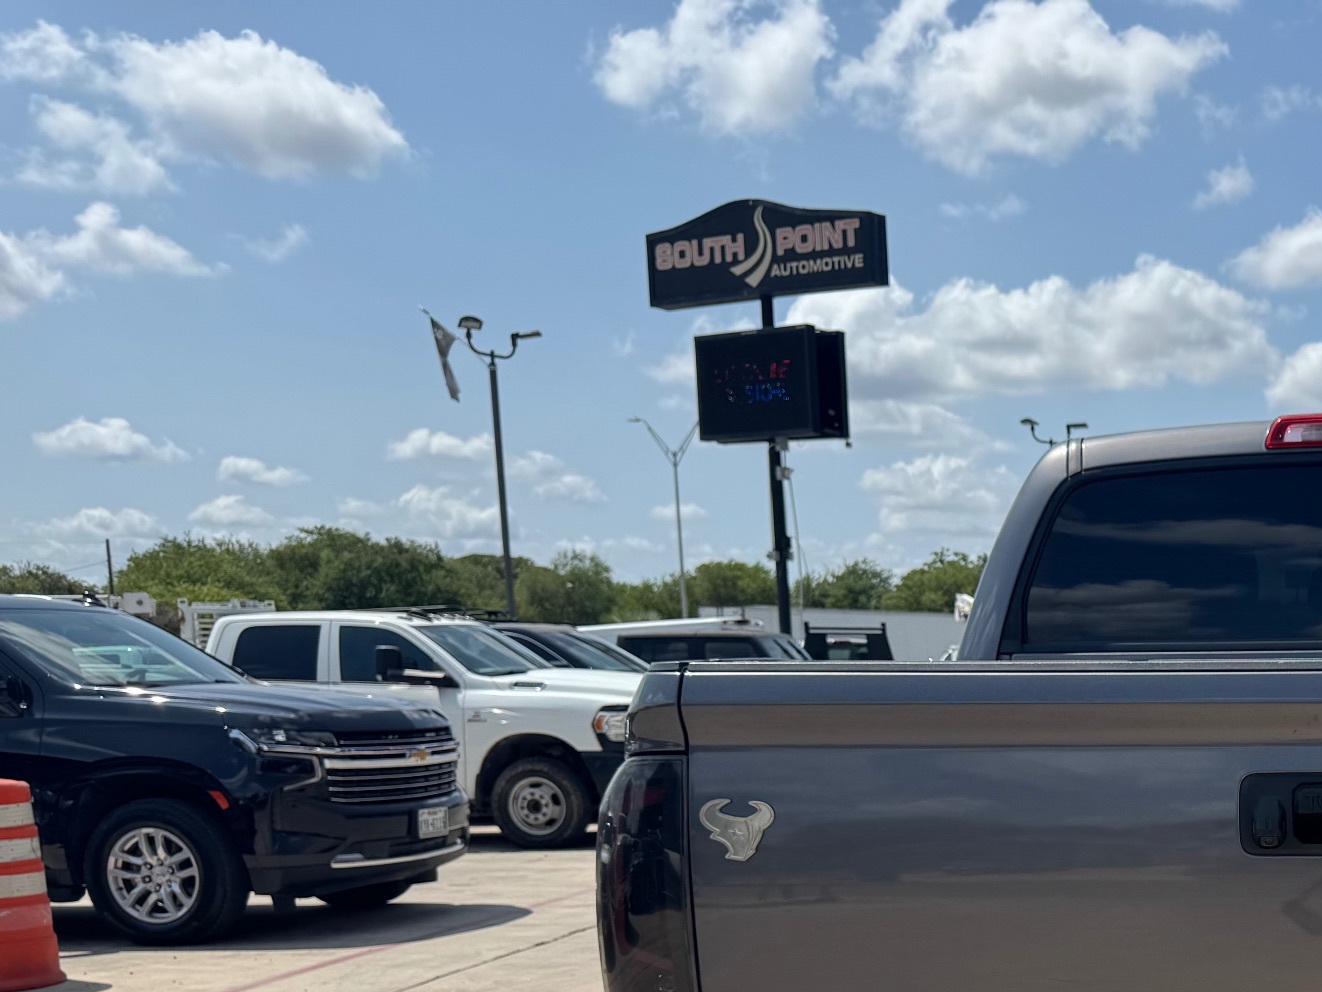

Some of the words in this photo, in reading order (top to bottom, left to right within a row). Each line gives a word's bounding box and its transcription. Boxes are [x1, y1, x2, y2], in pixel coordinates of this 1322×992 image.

[655, 233, 745, 271] SOUTH
[775, 218, 860, 256] POINT
[770, 253, 864, 278] AUTOMOTIVE
